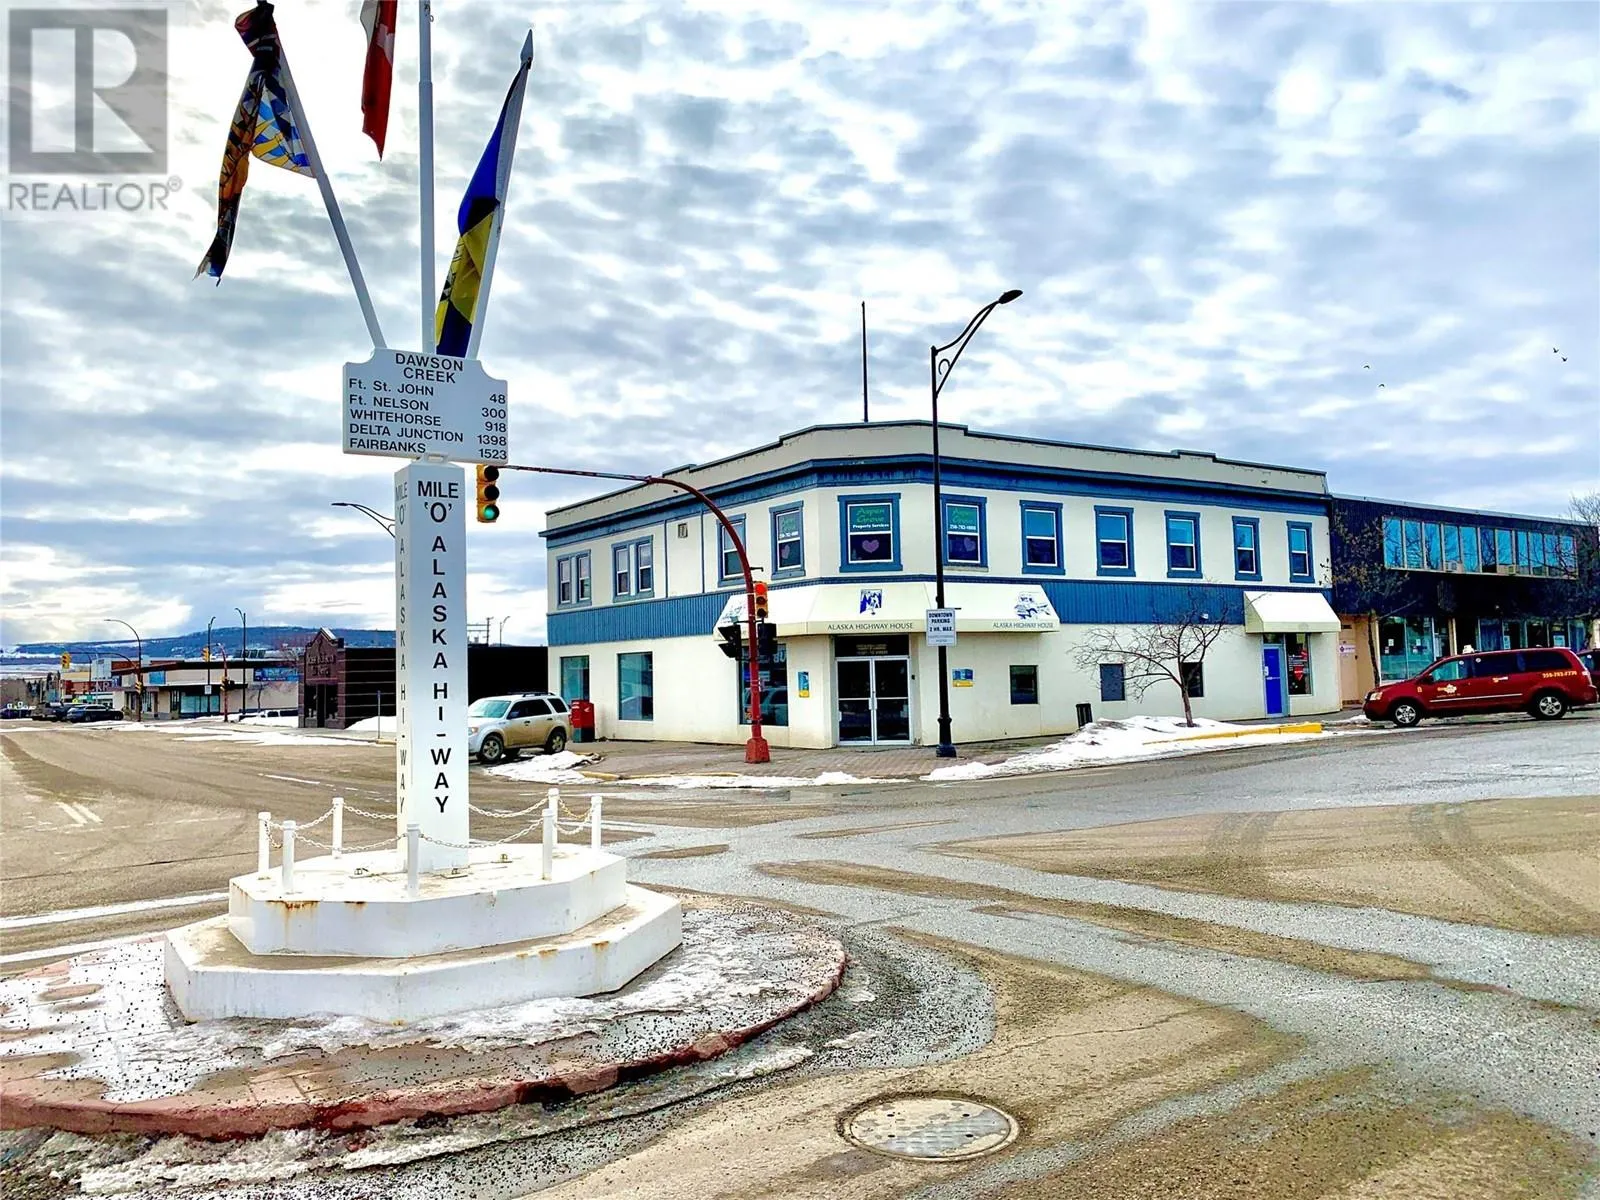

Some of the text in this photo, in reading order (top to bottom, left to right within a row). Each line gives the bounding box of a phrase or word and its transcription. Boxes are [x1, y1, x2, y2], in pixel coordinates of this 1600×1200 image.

[395, 353, 464, 372] DAWSON
[403, 367, 456, 384] CREEK
[349, 378, 434, 396] Ft. St. JOHN
[349, 394, 429, 411] Ft. NELSON
[489, 393, 506, 405] 48
[350, 409, 441, 427] WHITEHORSE
[481, 407, 507, 419] 300
[350, 423, 464, 443] DELTA JUNCTION
[484, 421, 507, 433] 918
[350, 438, 426, 454] FAIRBANKS
[477, 434, 507, 446] 1398
[479, 449, 507, 460] 1523
[395, 481, 408, 502] MILE
[417, 480, 459, 499] MILE
[431, 535, 448, 669] ALASKA
[827, 623, 854, 631] ALASKA
[889, 622, 913, 630] HOUSE
